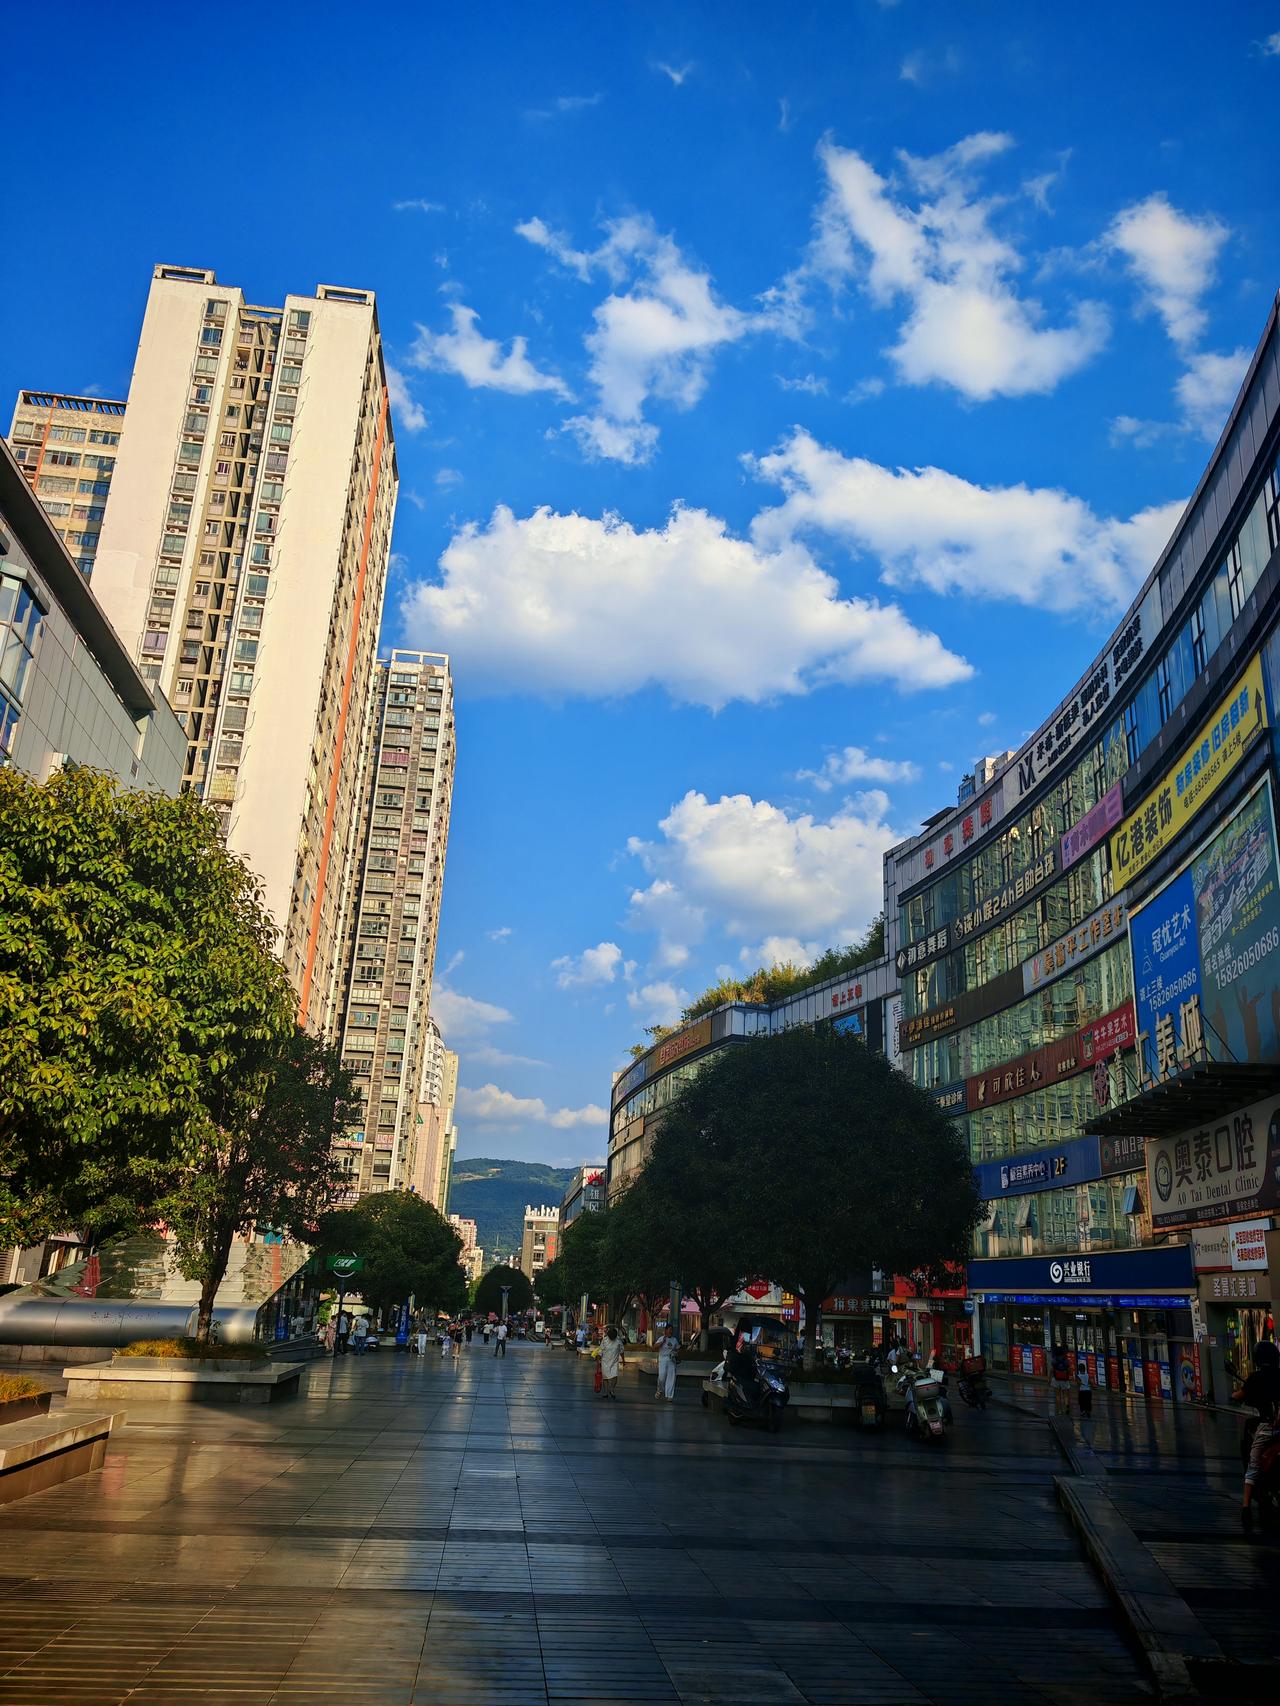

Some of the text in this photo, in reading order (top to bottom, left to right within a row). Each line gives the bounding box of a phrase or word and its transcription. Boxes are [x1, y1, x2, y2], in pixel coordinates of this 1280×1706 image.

[1115, 786, 1172, 872] 亿港装饰
[1215, 926, 1279, 993] 15826050686
[1149, 968, 1197, 1012] 15826050686
[1054, 1156, 1067, 1176] 2F
[1174, 1112, 1257, 1189] 奥泰口腔
[1190, 1187, 1202, 1203] Tai
[1206, 1180, 1232, 1200] Dental
[1235, 1174, 1259, 1194] Clinic
[1063, 1260, 1091, 1277] 兴业银行
[1213, 1277, 1257, 1297] 圣景汇美城
